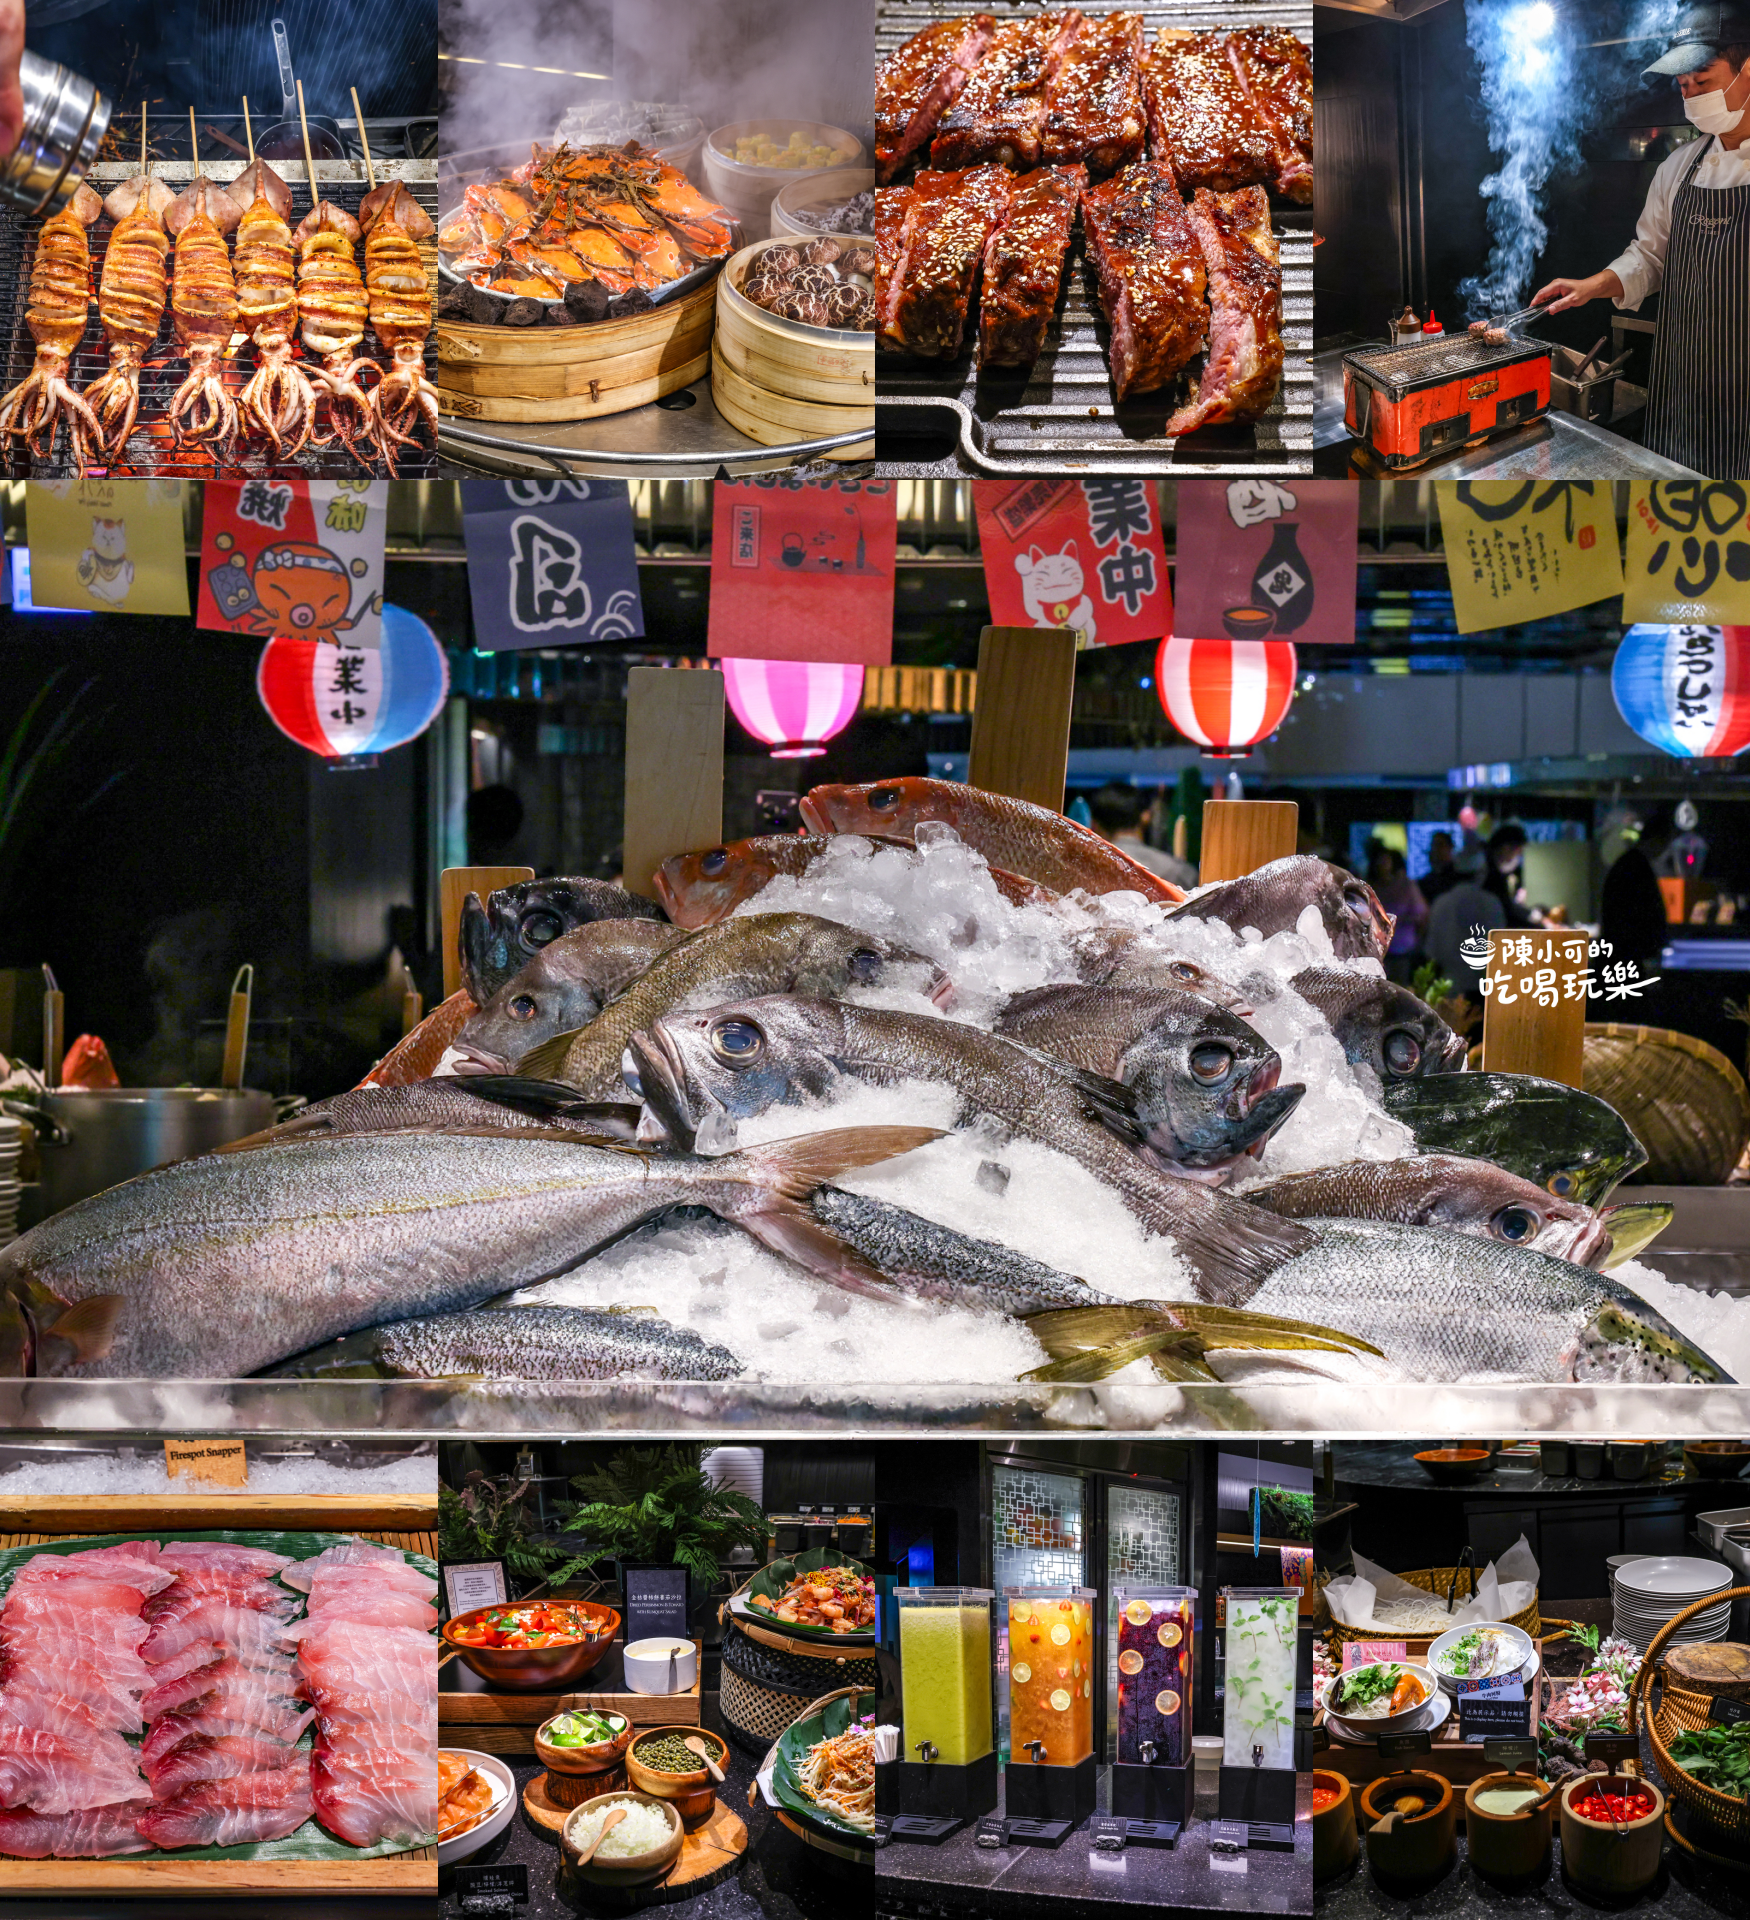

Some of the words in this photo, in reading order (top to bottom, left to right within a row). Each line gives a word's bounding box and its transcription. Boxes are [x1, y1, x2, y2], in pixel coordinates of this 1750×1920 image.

[739, 510, 754, 559] ご来店
[328, 646, 369, 724] 業中
[170, 1449, 205, 1461] Firespot
[206, 1446, 242, 1458] Snapper
[1343, 1642, 1407, 1657] BASSERIE
